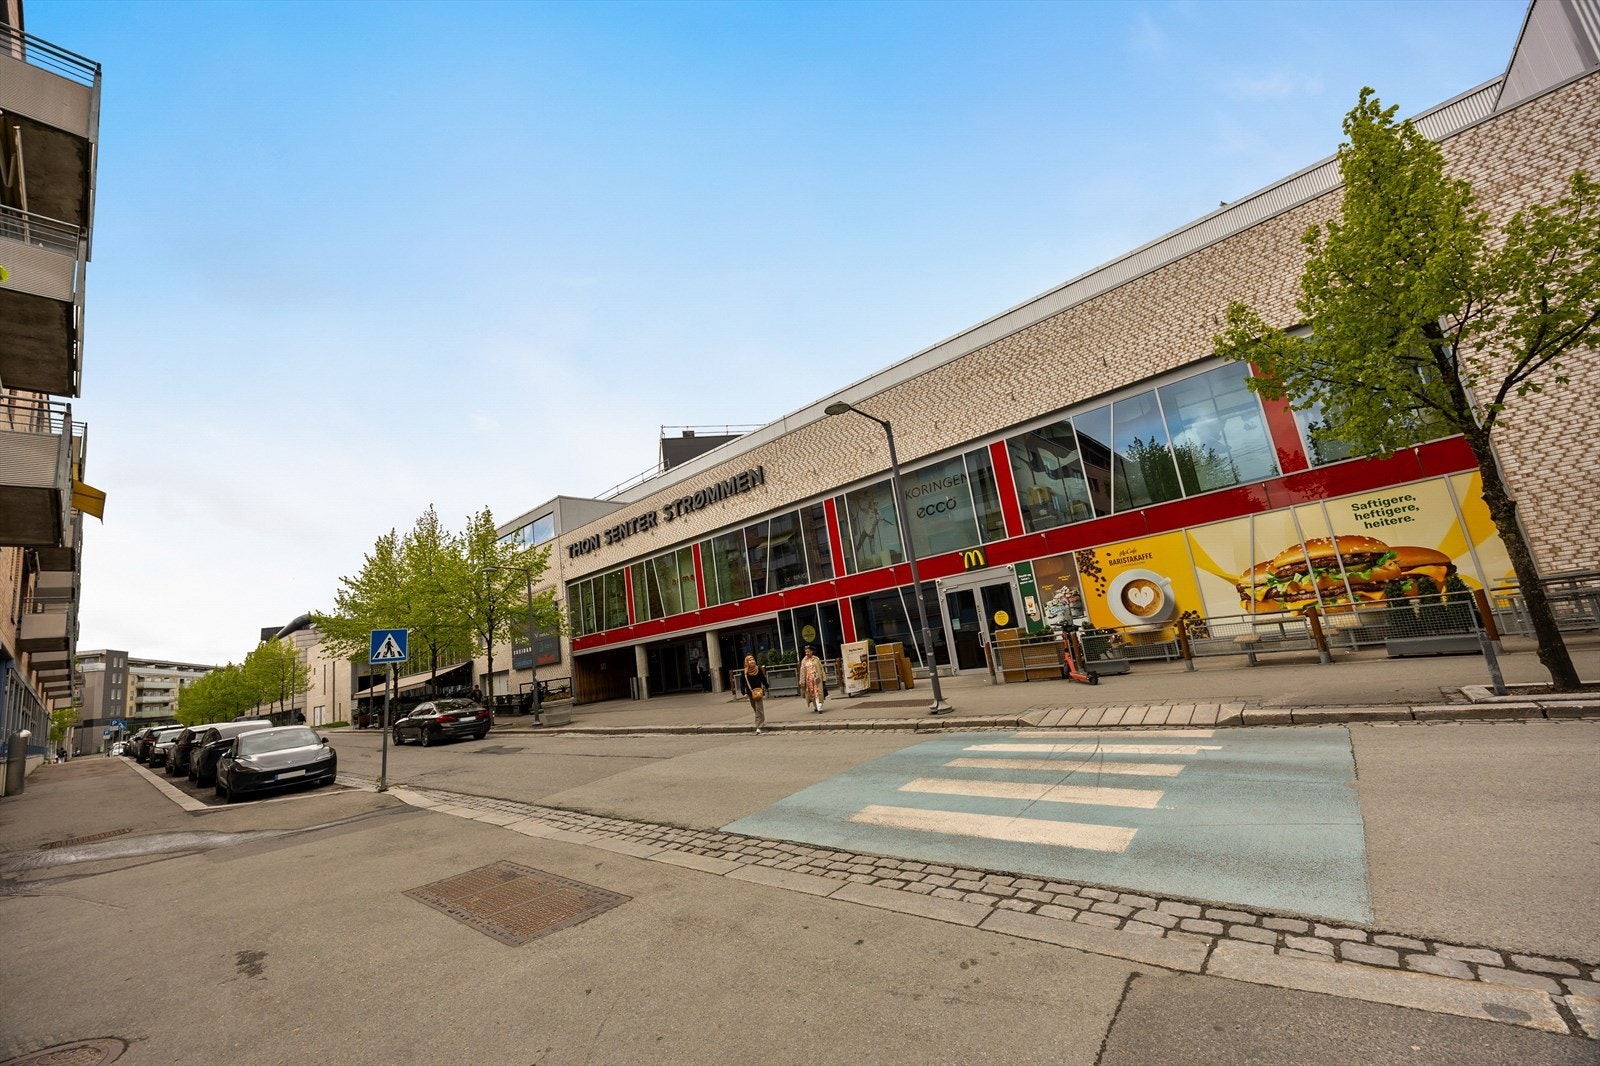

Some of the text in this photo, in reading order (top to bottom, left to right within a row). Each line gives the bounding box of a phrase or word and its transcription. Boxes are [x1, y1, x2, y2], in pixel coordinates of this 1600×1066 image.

[905, 472, 968, 501] KORINGEN
[1351, 494, 1416, 511] Saftigere,
[566, 465, 765, 559] THON SENTER STRØMMEN
[1354, 504, 1420, 521] heftigere,
[1364, 515, 1415, 529] heitere.
[1108, 552, 1153, 566] BARISTAKAFFE
